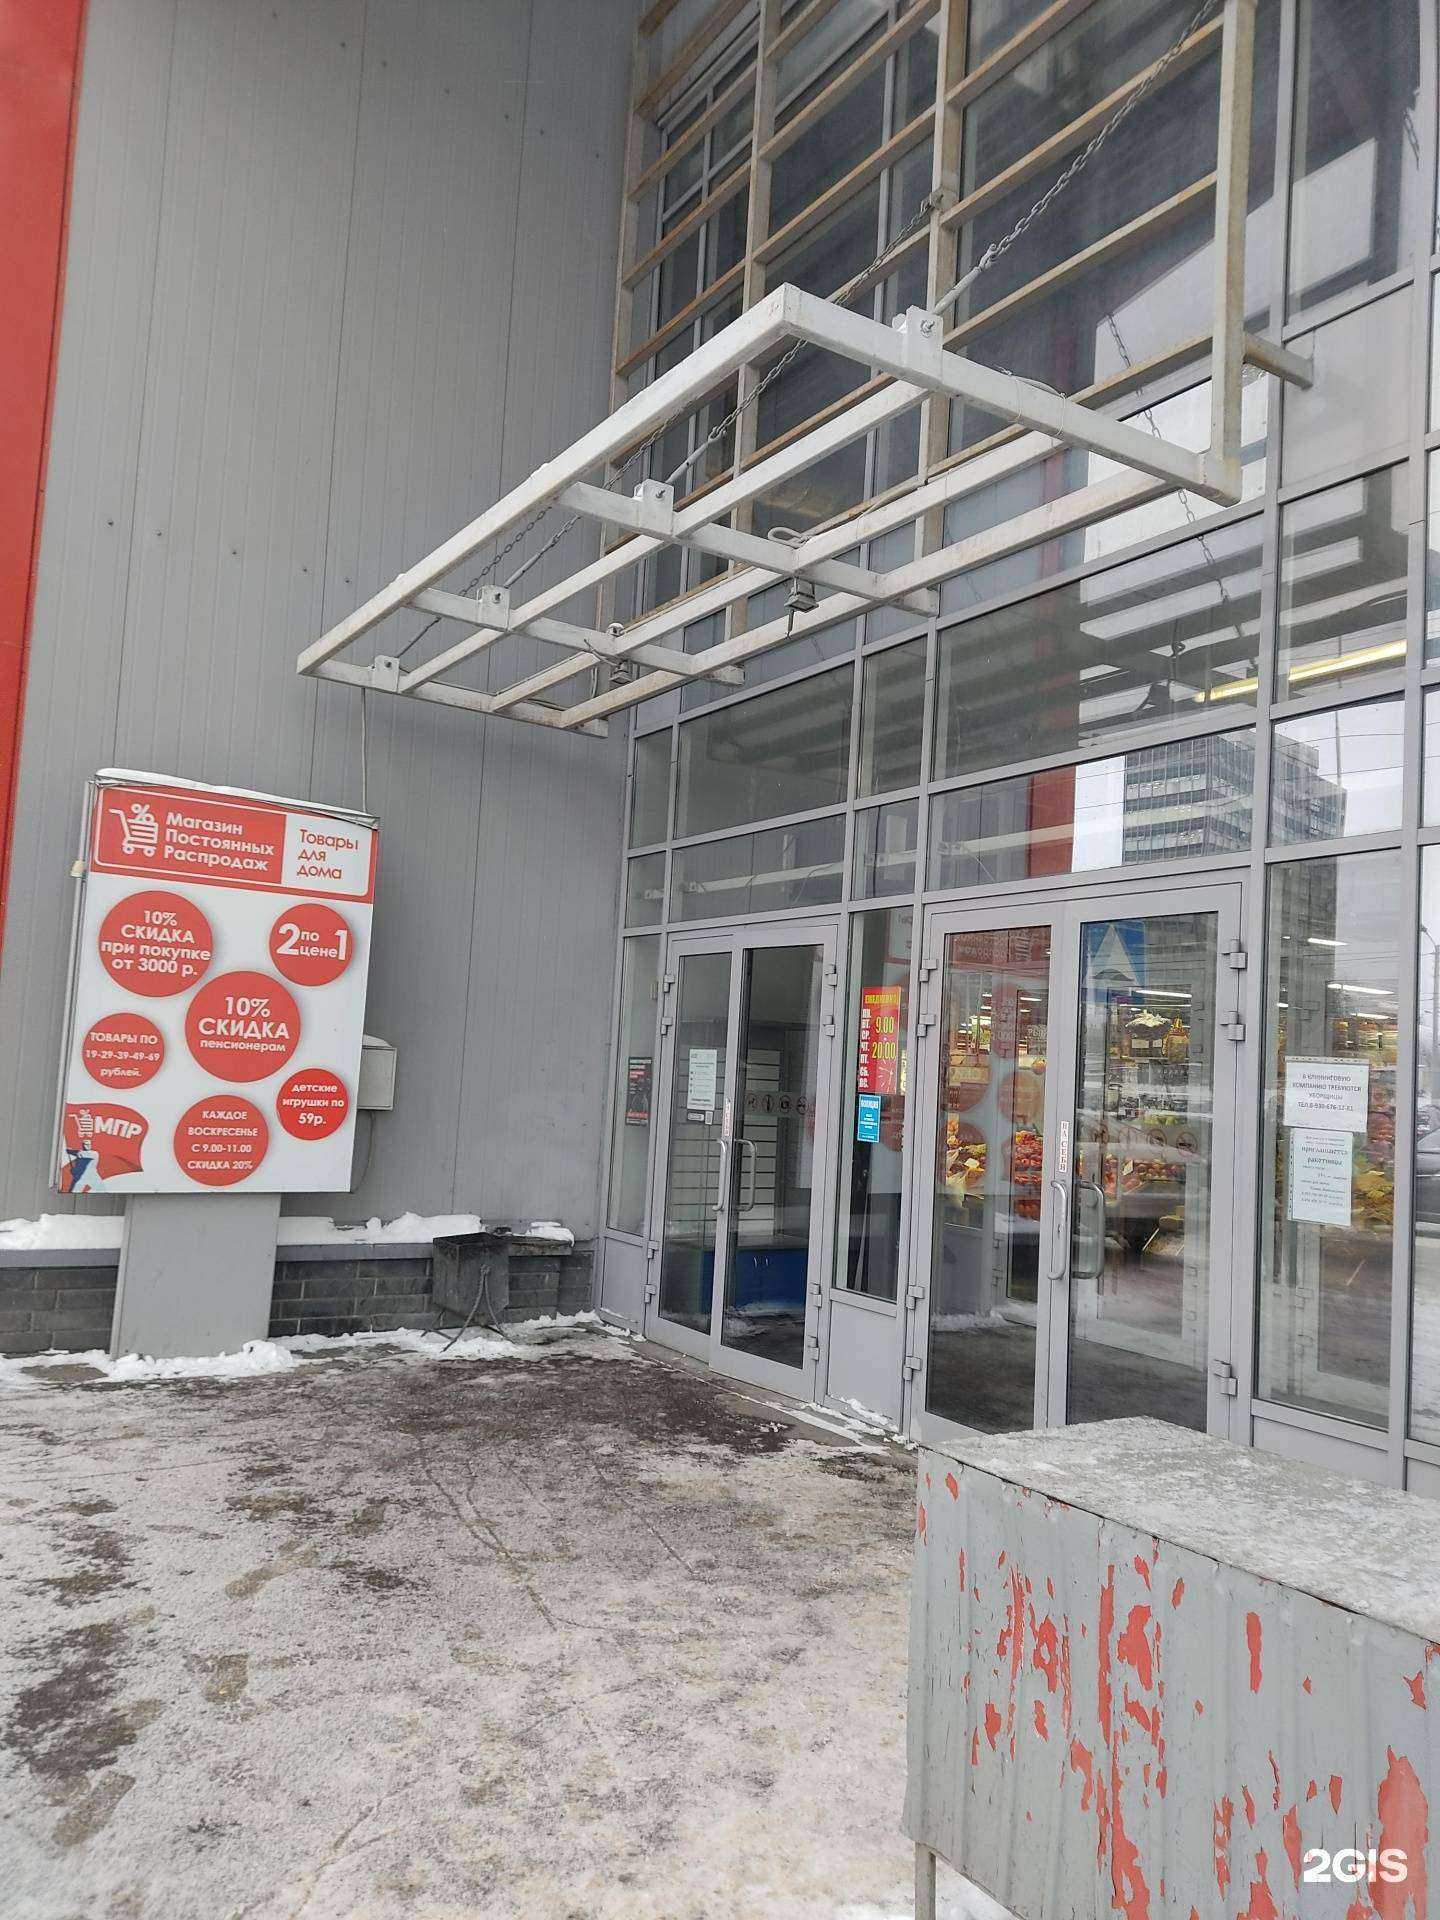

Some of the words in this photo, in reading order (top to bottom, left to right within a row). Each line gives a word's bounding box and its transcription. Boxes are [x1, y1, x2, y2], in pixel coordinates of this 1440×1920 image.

[166, 811, 243, 835] Магазин
[165, 828, 274, 856] Постоянных
[299, 829, 359, 851] Товары
[164, 845, 268, 872] Распродаж
[298, 848, 327, 862] для
[297, 862, 343, 880] дома
[144, 910, 177, 926] 10%
[120, 924, 195, 945] СКИДКА
[276, 923, 300, 955] 2
[301, 931, 320, 942] по
[101, 940, 135, 955] при
[140, 944, 211, 962] покупке
[300, 945, 338, 958] цене
[334, 929, 348, 961] 1
[112, 958, 132, 970] от
[138, 957, 178, 973] 3000
[181, 962, 197, 978] р.
[225, 996, 271, 1018] 10%
[198, 1017, 290, 1040] СКИДКА
[90, 1032, 137, 1044] ТОВАРЫ
[140, 1034, 158, 1044] ПО
[199, 1039, 286, 1054] пенсионерам
[292, 1084, 338, 1093] детские
[282, 1098, 329, 1108] игрушки
[331, 1099, 345, 1107] по
[202, 1110, 248, 1120] КАЖДОЕ
[95, 1116, 142, 1140] МПР
[188, 1127, 258, 1137] ВОСКРЕСЕНЬЕ
[192, 1144, 201, 1152] С
[202, 1144, 252, 1153] 9.00-11.00
[187, 1160, 230, 1170] СКИДКА
[233, 1160, 253, 1170] 20%
